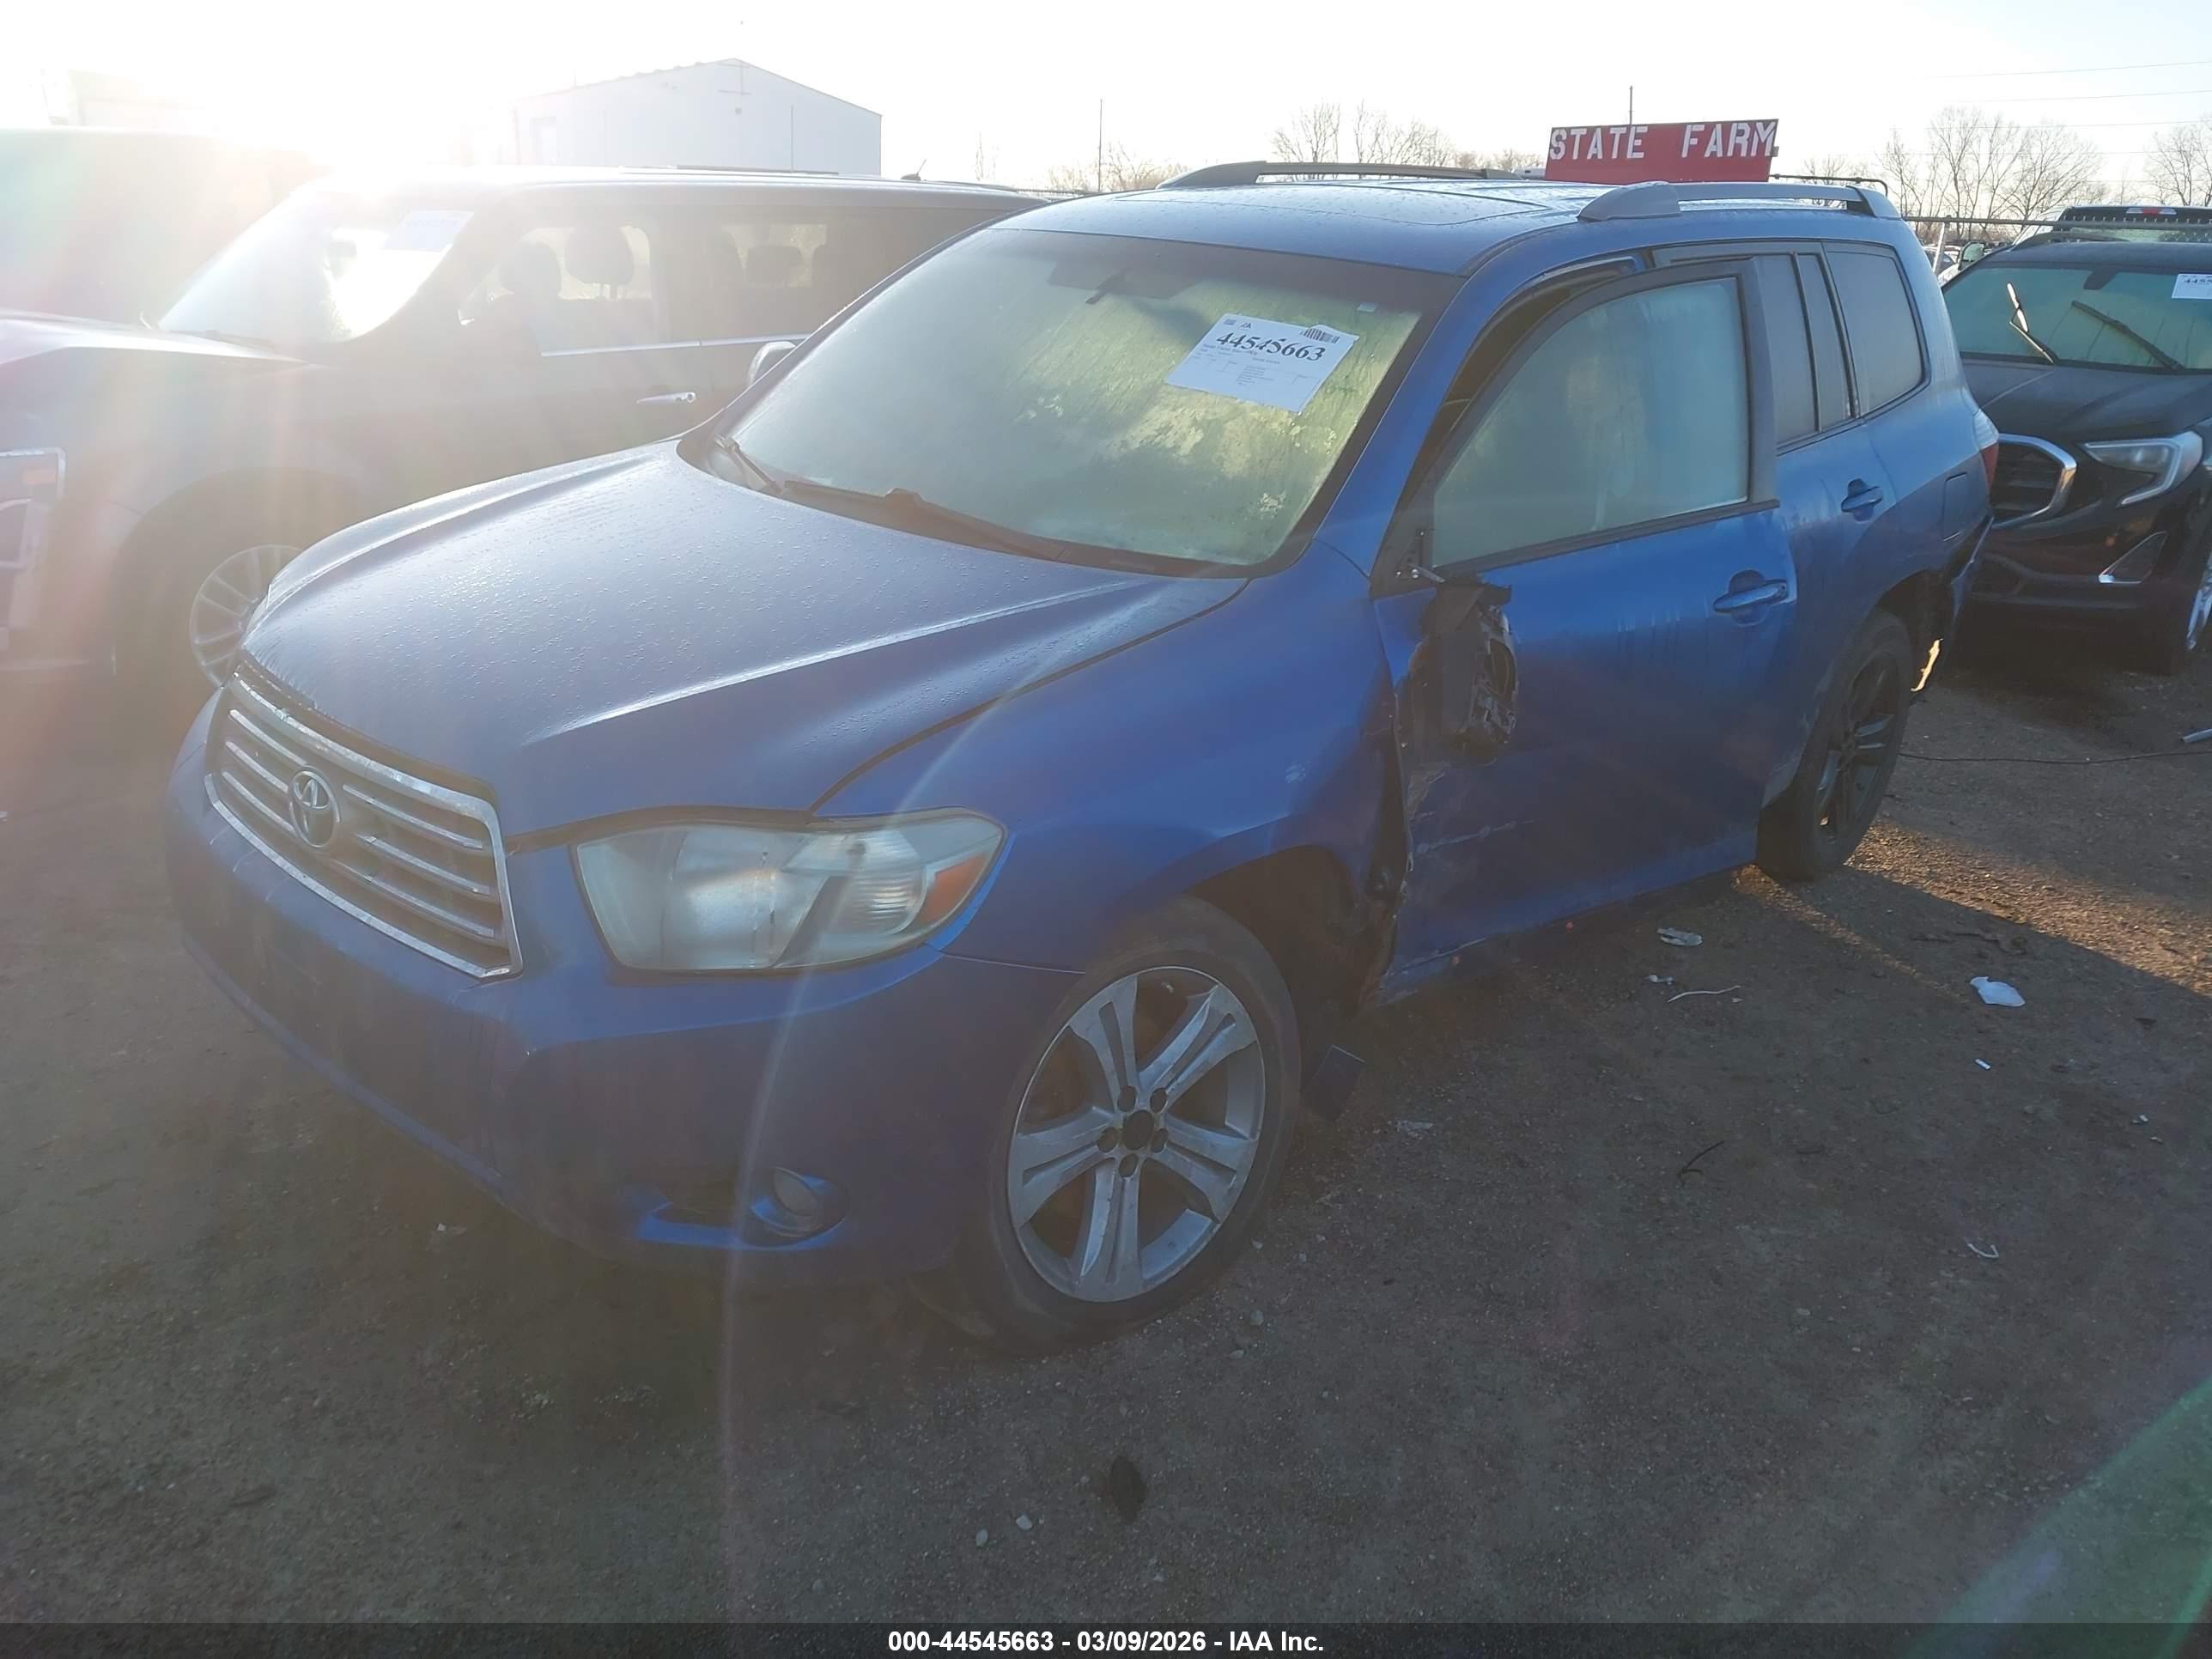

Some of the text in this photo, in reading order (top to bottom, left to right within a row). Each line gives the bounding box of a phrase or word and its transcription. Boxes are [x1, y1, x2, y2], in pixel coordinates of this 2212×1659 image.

[1549, 121, 1776, 160] STATE FARM
[1216, 332, 1326, 362] 44545663
